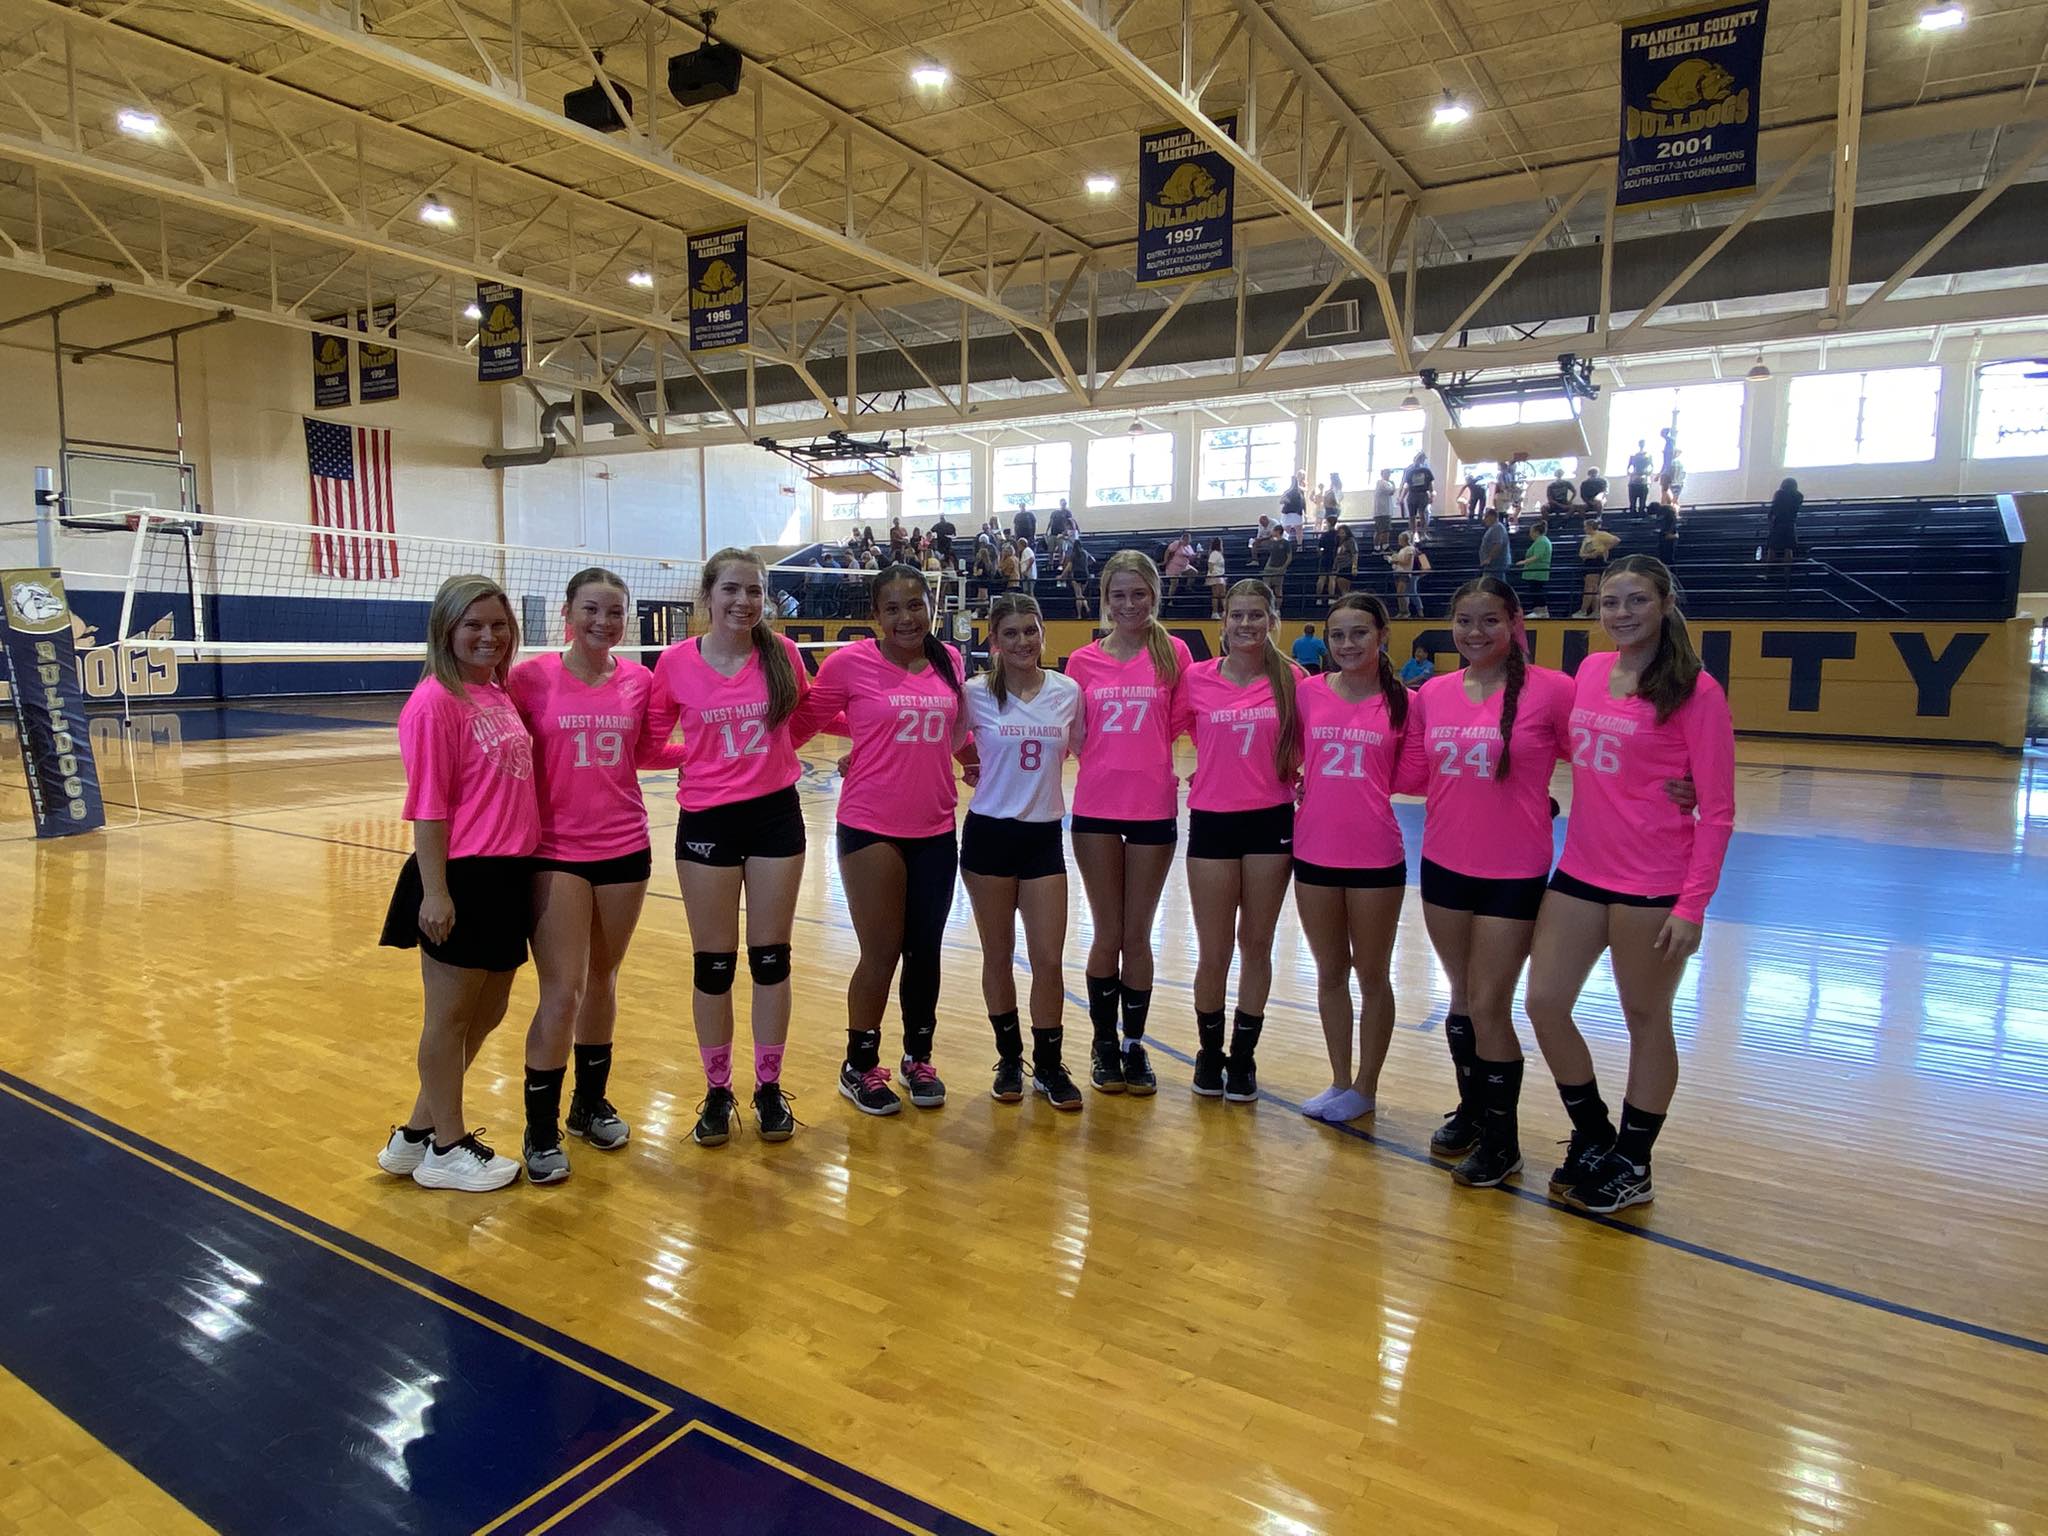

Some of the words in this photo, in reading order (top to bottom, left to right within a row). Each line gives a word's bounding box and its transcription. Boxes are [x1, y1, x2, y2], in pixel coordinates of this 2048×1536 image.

[1631, 22, 1700, 49] FRANKLIN
[1704, 9, 1759, 33] COUNTY
[1648, 30, 1737, 61] BASKETBALL
[1626, 87, 1750, 141] BULLDOGS
[1145, 132, 1193, 153] FRANKLIN
[1657, 134, 1713, 159] 2001
[1623, 176, 1653, 190] SOUTH
[1653, 173, 1682, 185] STATE
[1683, 162, 1747, 179] TOURNAMENT
[1627, 162, 1667, 177] DISTRICT
[1688, 150, 1745, 167] CHAMPIONS
[1145, 187, 1228, 231] BULLDOGS
[1164, 226, 1204, 245] 1997
[1146, 247, 1172, 261] DISTRICT
[1186, 238, 1224, 253] CHAMPIONS
[1146, 258, 1166, 271] SOUTH
[1165, 255, 1184, 267] STATE
[1184, 248, 1223, 264] CHAMPIONS
[1156, 266, 1175, 278] STATE
[706, 310, 732, 324] 1996
[494, 347, 513, 360] 1995
[888, 695, 918, 708] WEST
[1093, 687, 1121, 700] WEST
[1122, 686, 1158, 699] MARION
[558, 715, 592, 730] WEST
[594, 714, 635, 731] MARION
[700, 707, 733, 725] WEST
[895, 709, 947, 744] 20
[1101, 699, 1149, 733] 27
[1210, 710, 1238, 724] WEST
[1239, 706, 1277, 721] MARION
[1593, 714, 1639, 736] MARION
[35, 640, 88, 821] BULLDOGS
[719, 719, 769, 758] 12
[1000, 725, 1026, 738] WEST
[1028, 726, 1063, 739] MARION
[1231, 721, 1256, 756] 7
[1311, 726, 1342, 741] WEST
[1342, 728, 1384, 747] MARION
[1430, 726, 1460, 740] WEST
[573, 731, 624, 768] 19
[1019, 738, 1042, 772] 8
[1321, 742, 1366, 779] 21
[1433, 740, 1492, 778] 24
[1570, 726, 1622, 774] 26
